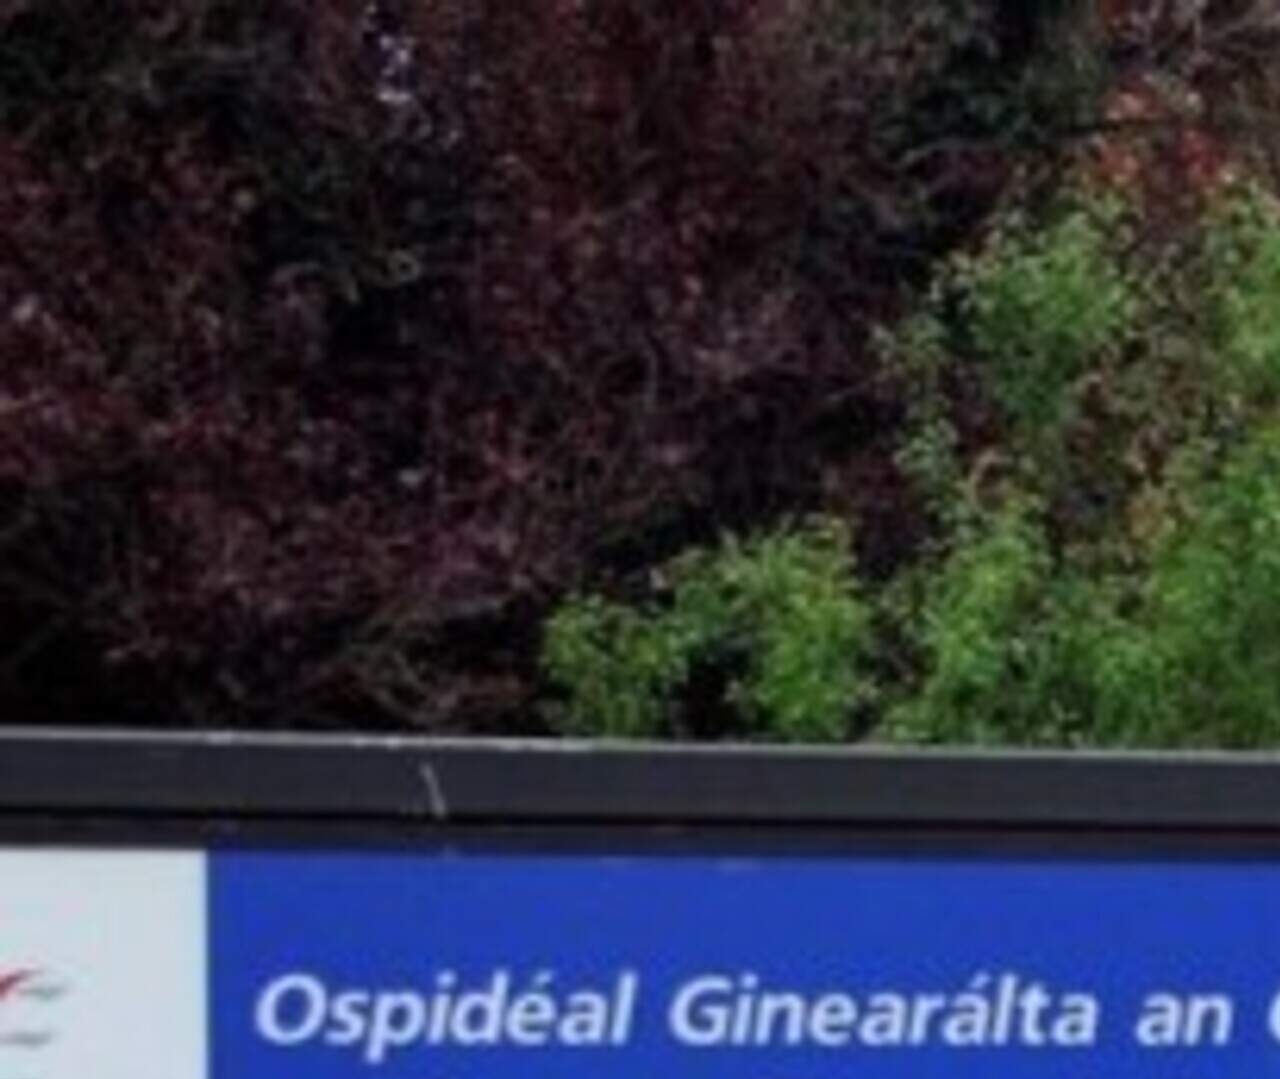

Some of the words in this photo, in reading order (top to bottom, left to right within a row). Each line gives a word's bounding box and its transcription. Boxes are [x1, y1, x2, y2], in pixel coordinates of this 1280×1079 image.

[254, 970, 638, 1064] Ospidéal
[667, 972, 1100, 1047] Ginearálta
[1135, 992, 1233, 1047] an
